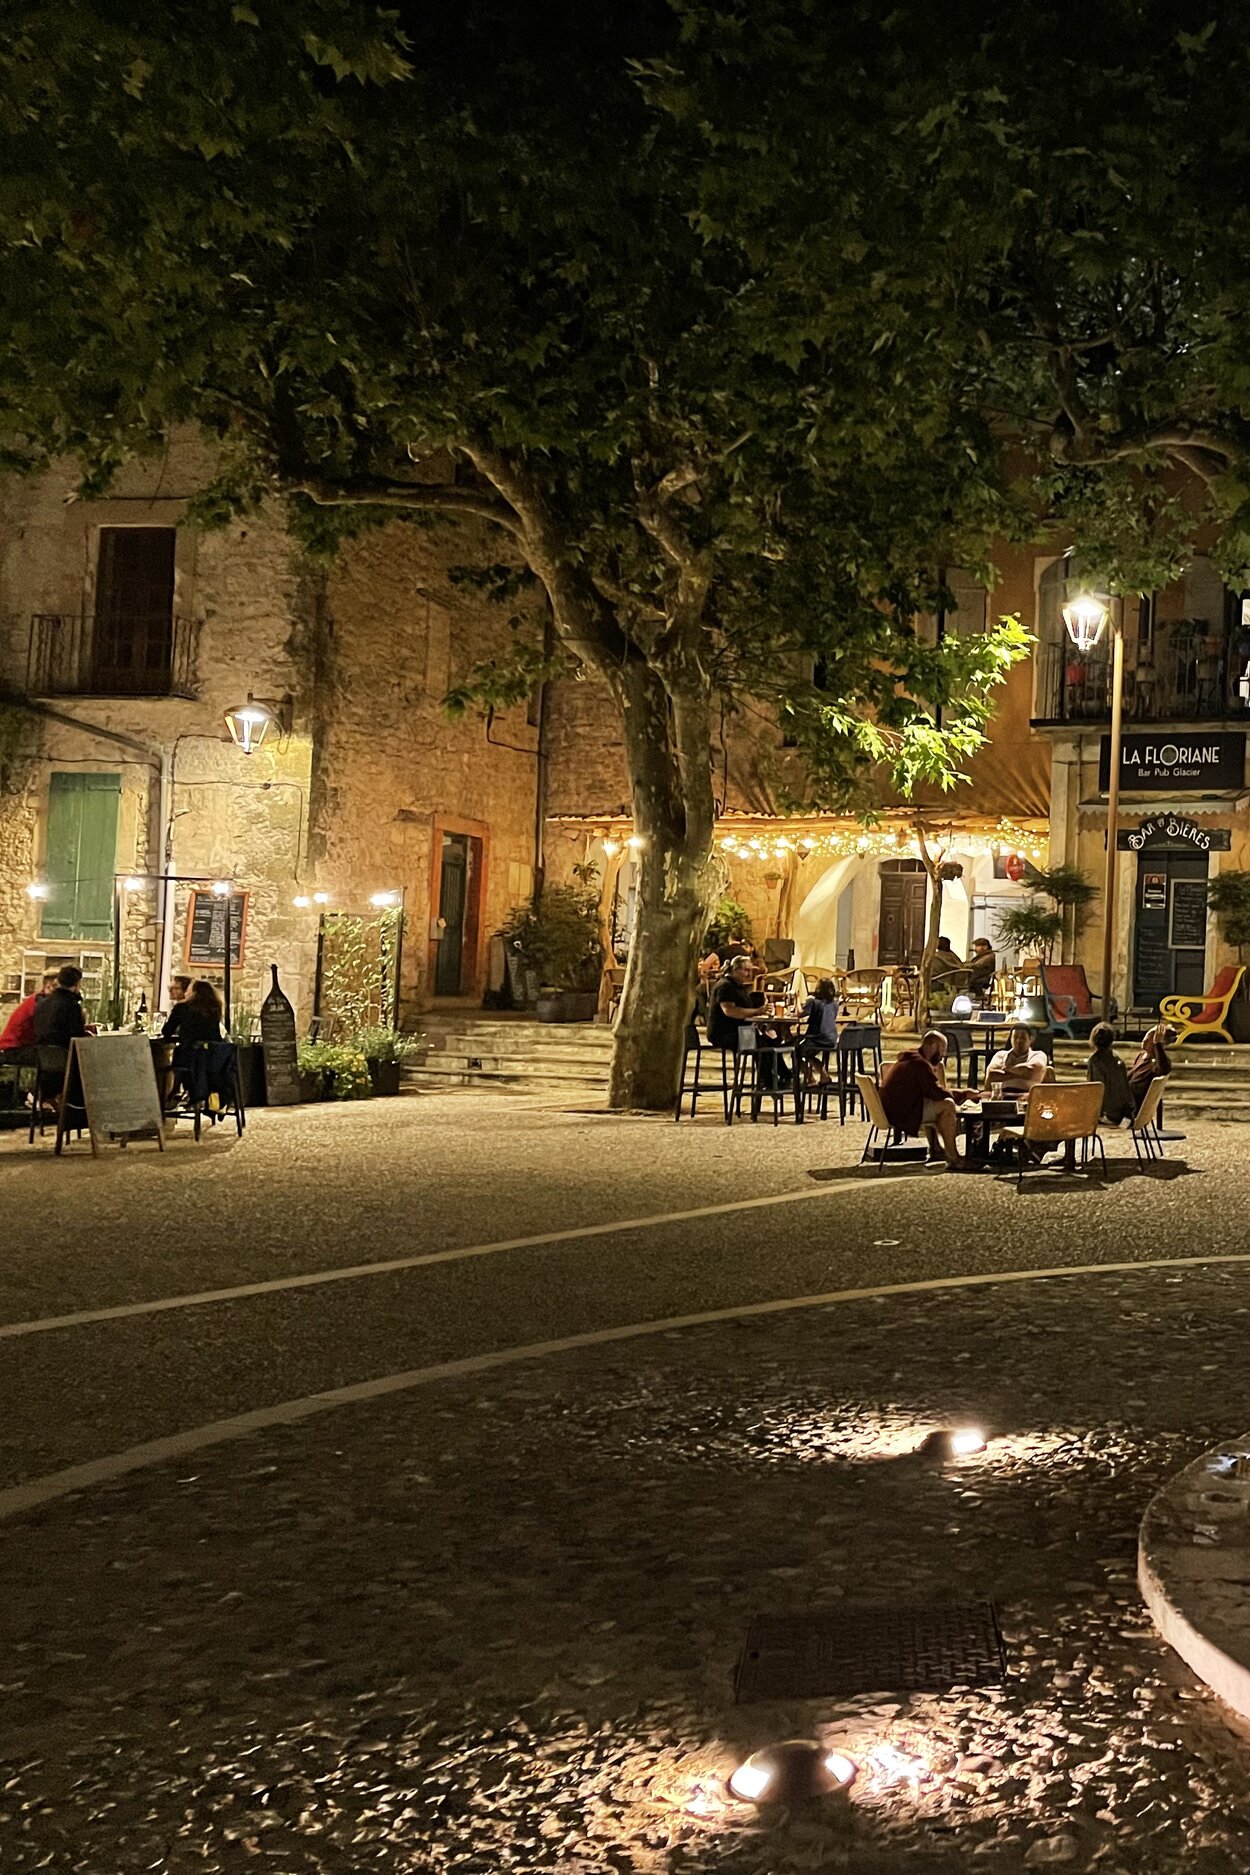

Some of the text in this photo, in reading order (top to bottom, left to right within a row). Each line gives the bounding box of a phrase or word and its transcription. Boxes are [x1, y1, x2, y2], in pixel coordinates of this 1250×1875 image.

[1122, 744, 1220, 766] LA FLORIANE
[1138, 767, 1201, 777] Bar Pub Glacier
[1127, 822, 1156, 850] BAR
